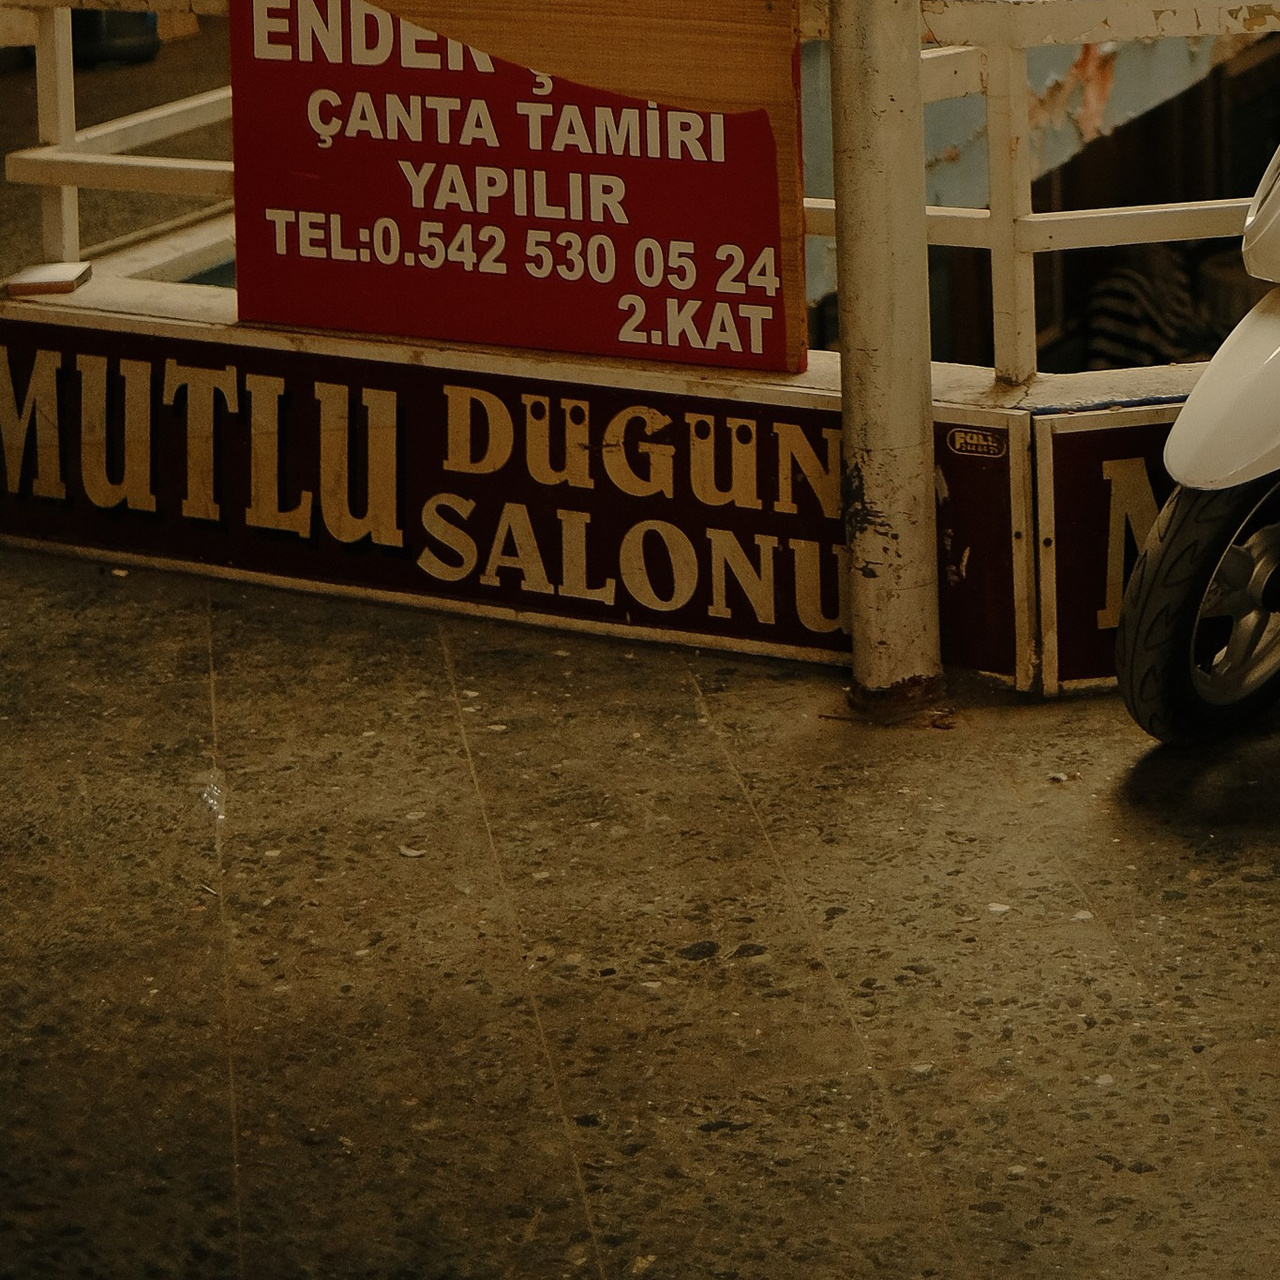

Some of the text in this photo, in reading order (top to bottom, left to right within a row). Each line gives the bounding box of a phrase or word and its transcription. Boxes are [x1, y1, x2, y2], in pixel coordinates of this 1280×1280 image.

[306, 89, 500, 149] ÇANTA
[397, 160, 630, 225] YAPILIR
[265, 208, 781, 298] TEL:0.542 530 05 24
[616, 293, 774, 356] 2.KAT
[0, 345, 404, 548] MUTLU
[416, 492, 853, 635] SALONU
